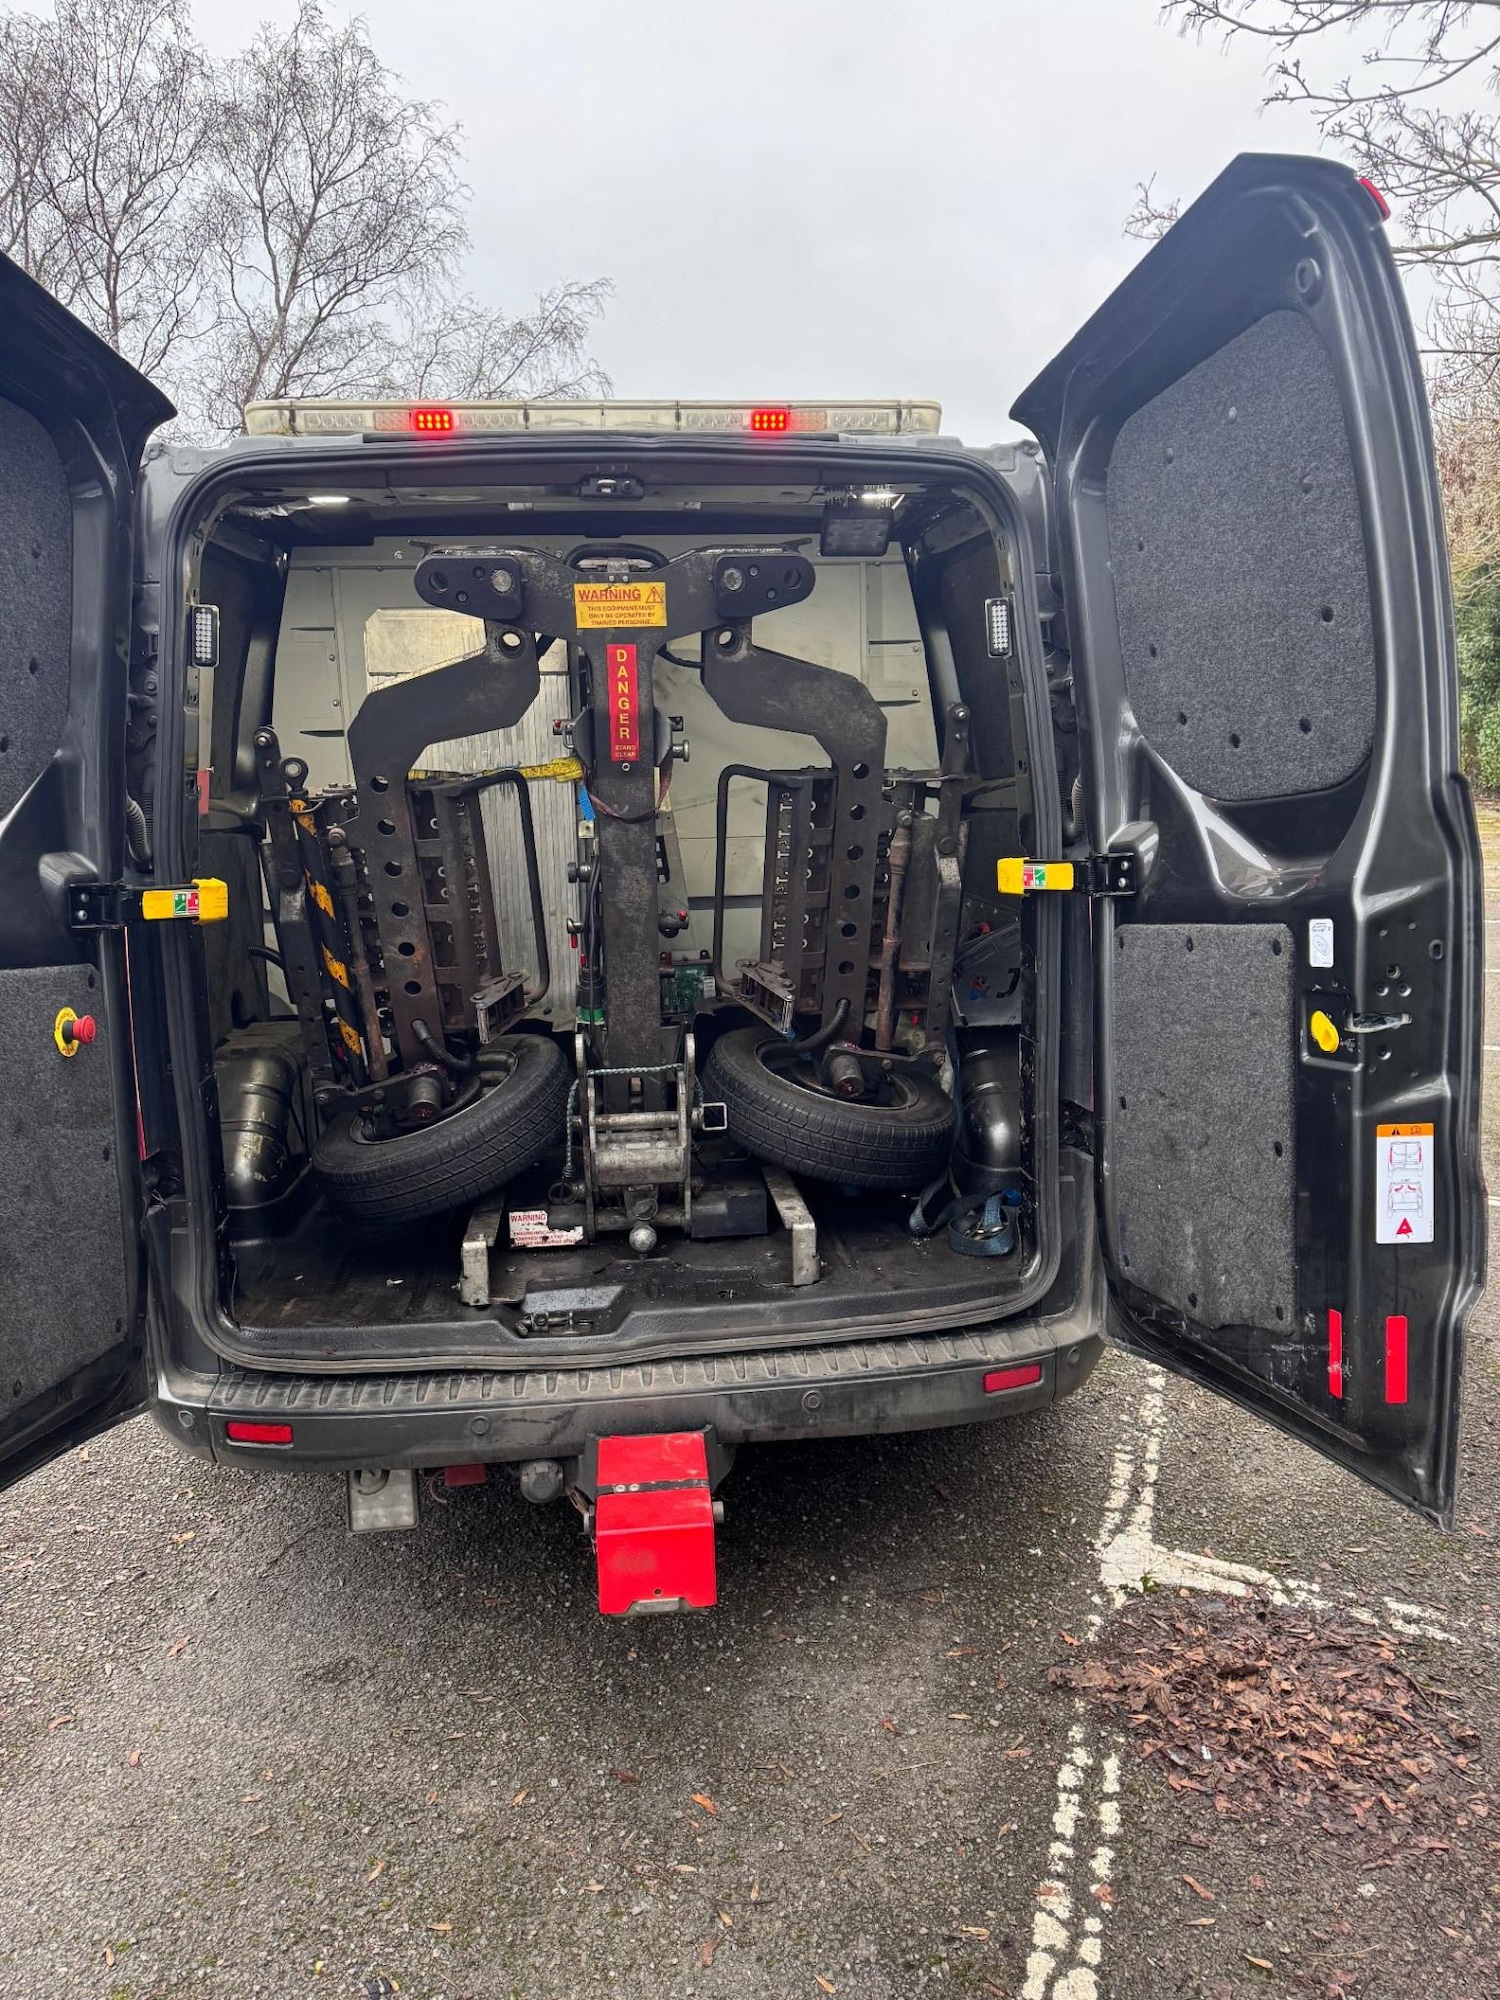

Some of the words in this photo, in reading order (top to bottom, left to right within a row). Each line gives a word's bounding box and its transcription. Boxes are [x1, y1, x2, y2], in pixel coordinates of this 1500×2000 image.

[578, 588, 641, 600] WARNING
[616, 649, 630, 739] DANGER
[510, 1214, 546, 1222] WARNING
